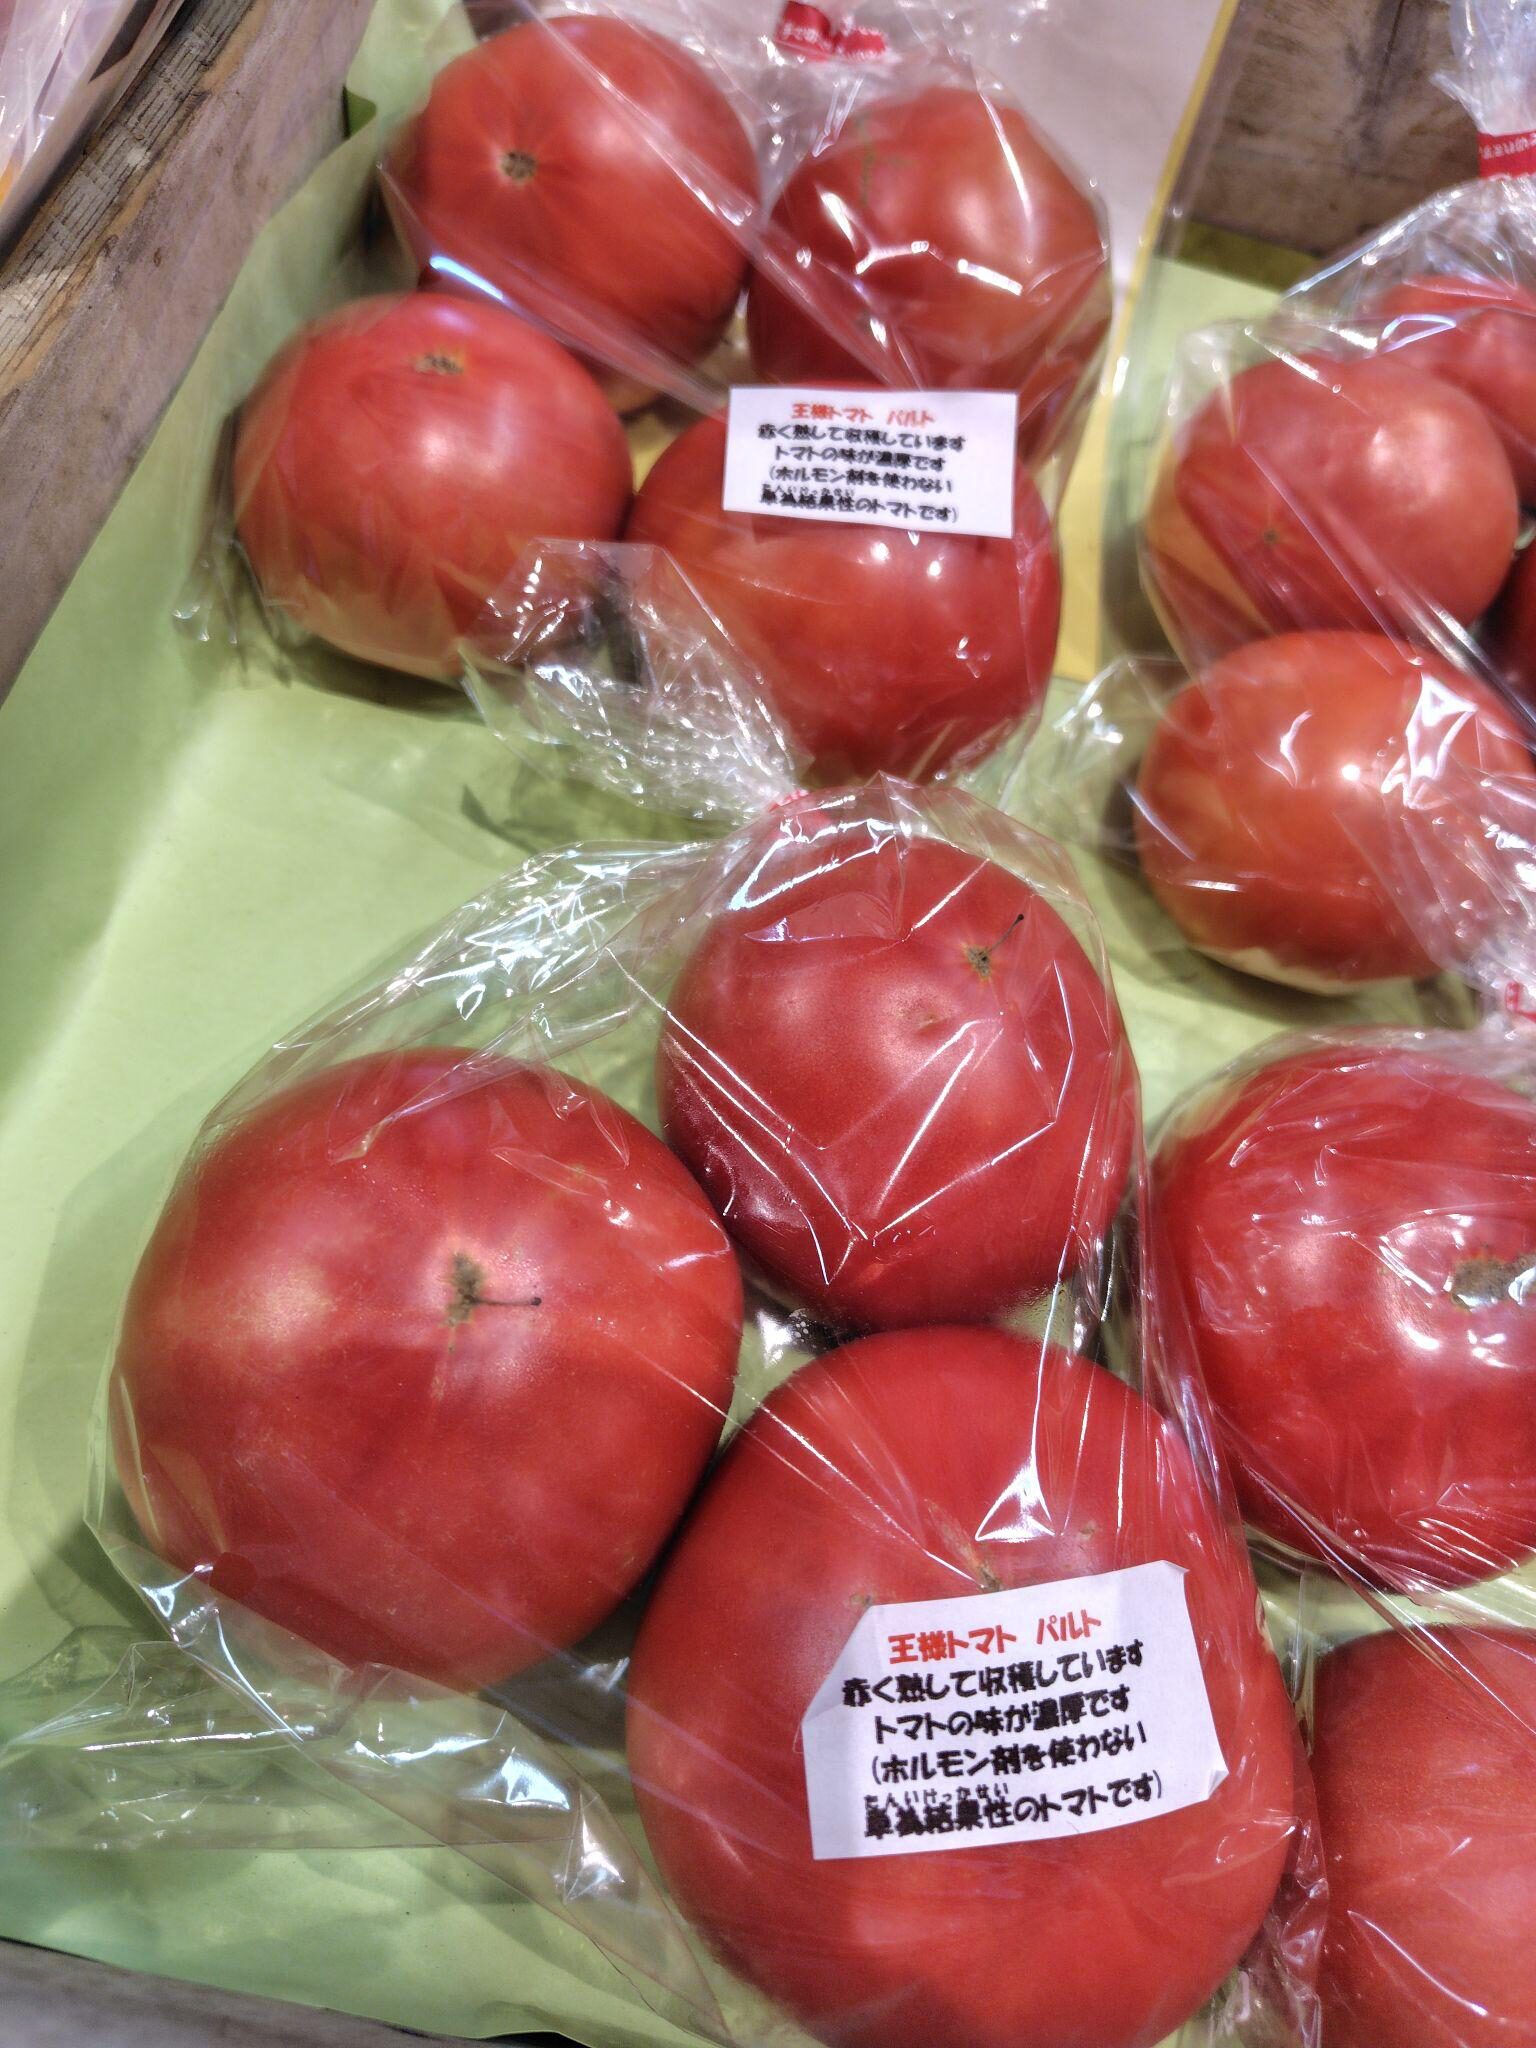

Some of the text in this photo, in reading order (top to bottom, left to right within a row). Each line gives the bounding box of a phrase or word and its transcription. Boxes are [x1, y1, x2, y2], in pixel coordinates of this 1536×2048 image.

[757, 424, 966, 452] 赤く熟して収穫しています
[791, 403, 873, 421] 王様トマト
[774, 445, 946, 472] トマトの味が濃厚です
[888, 1609, 1103, 1664] 王様トマト パルト
[841, 1638, 1145, 1708] 赤く熟して収穫しています
[874, 1684, 1131, 1744] トマトの味が濃厚です
[870, 1721, 1148, 1785] (ホルモン剤を使わない
